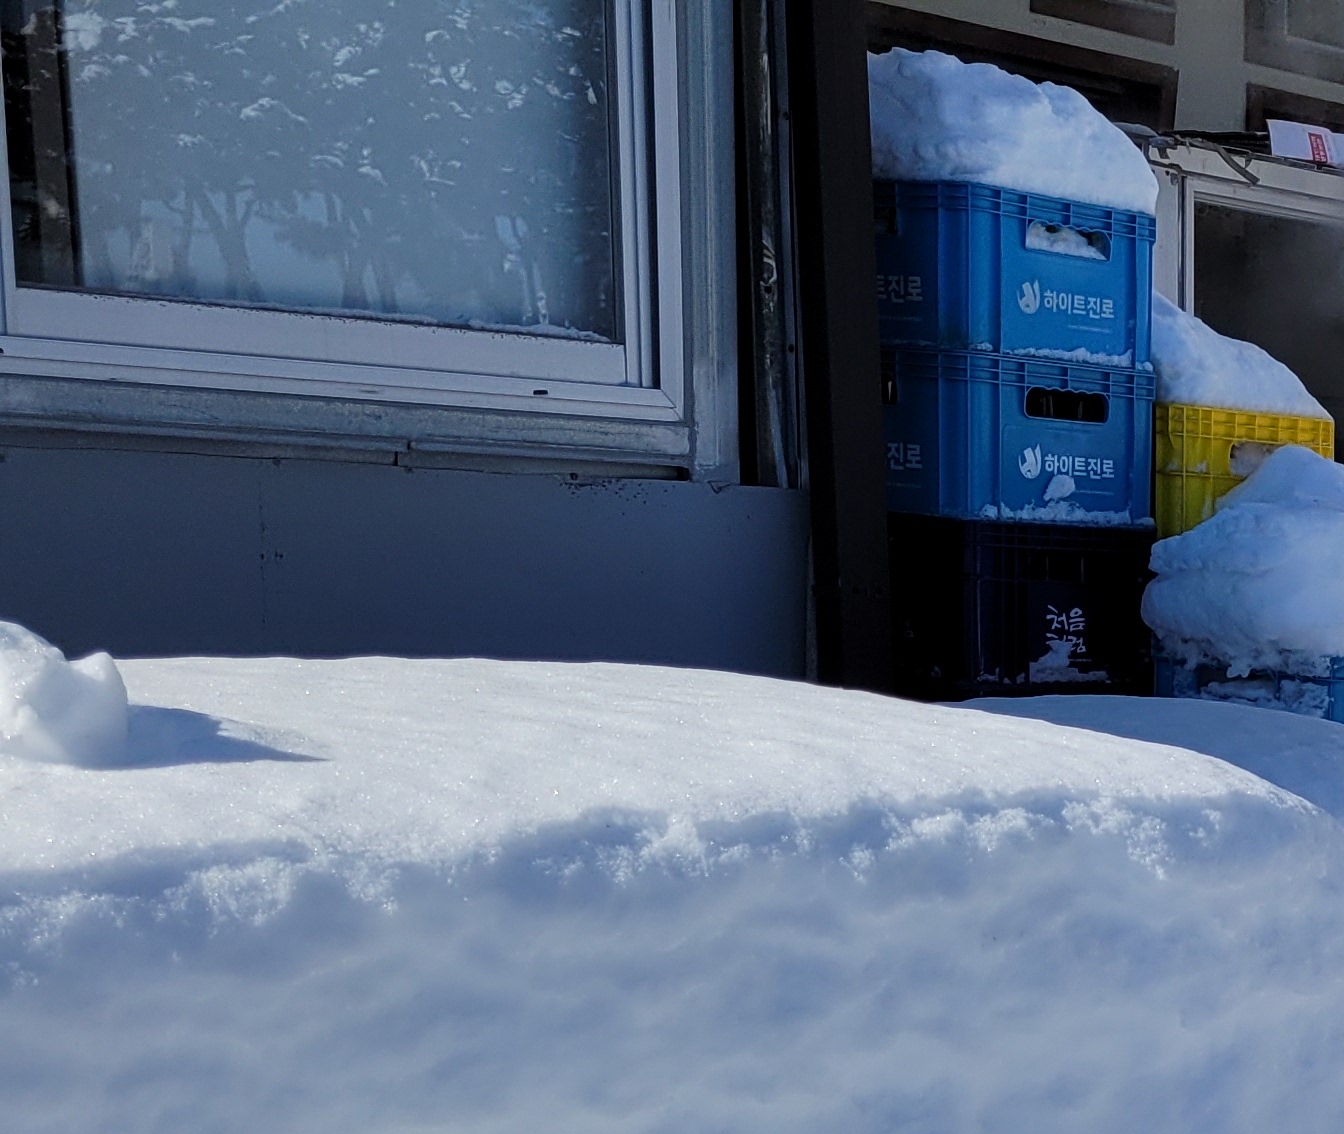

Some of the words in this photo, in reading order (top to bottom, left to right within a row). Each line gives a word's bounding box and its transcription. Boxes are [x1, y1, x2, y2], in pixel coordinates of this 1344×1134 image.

[1043, 290, 1115, 319] 하이트진로
[1044, 453, 1115, 480] 하이트진로
[1046, 605, 1086, 632] 처음
